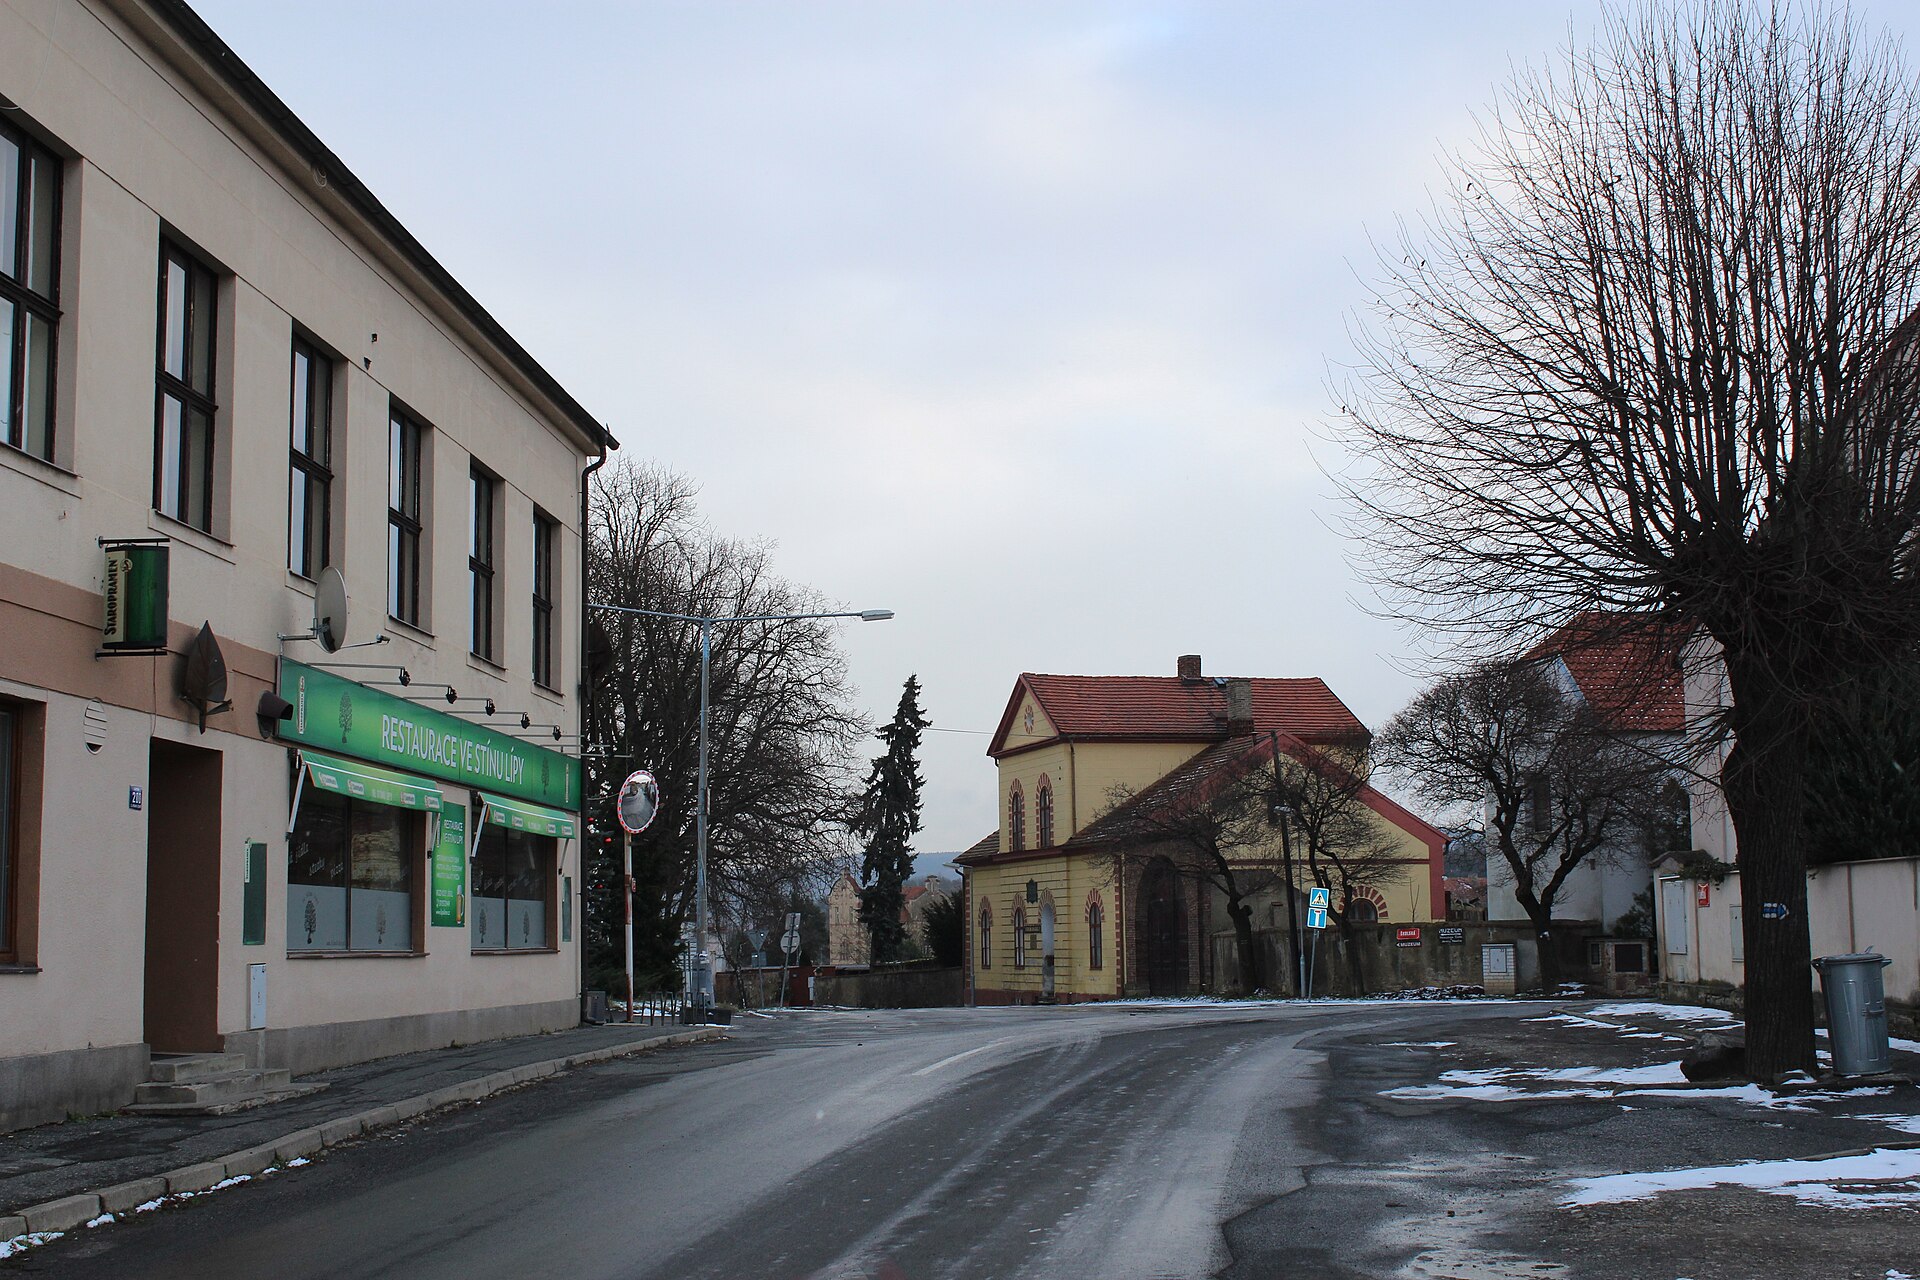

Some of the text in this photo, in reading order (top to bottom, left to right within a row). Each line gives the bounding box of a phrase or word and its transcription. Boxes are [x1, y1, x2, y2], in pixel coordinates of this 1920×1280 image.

[382, 714, 457, 768] RESTAURACE
[459, 737, 473, 772] VE
[474, 738, 504, 780] STÍNU
[505, 746, 525, 785] LÍPY
